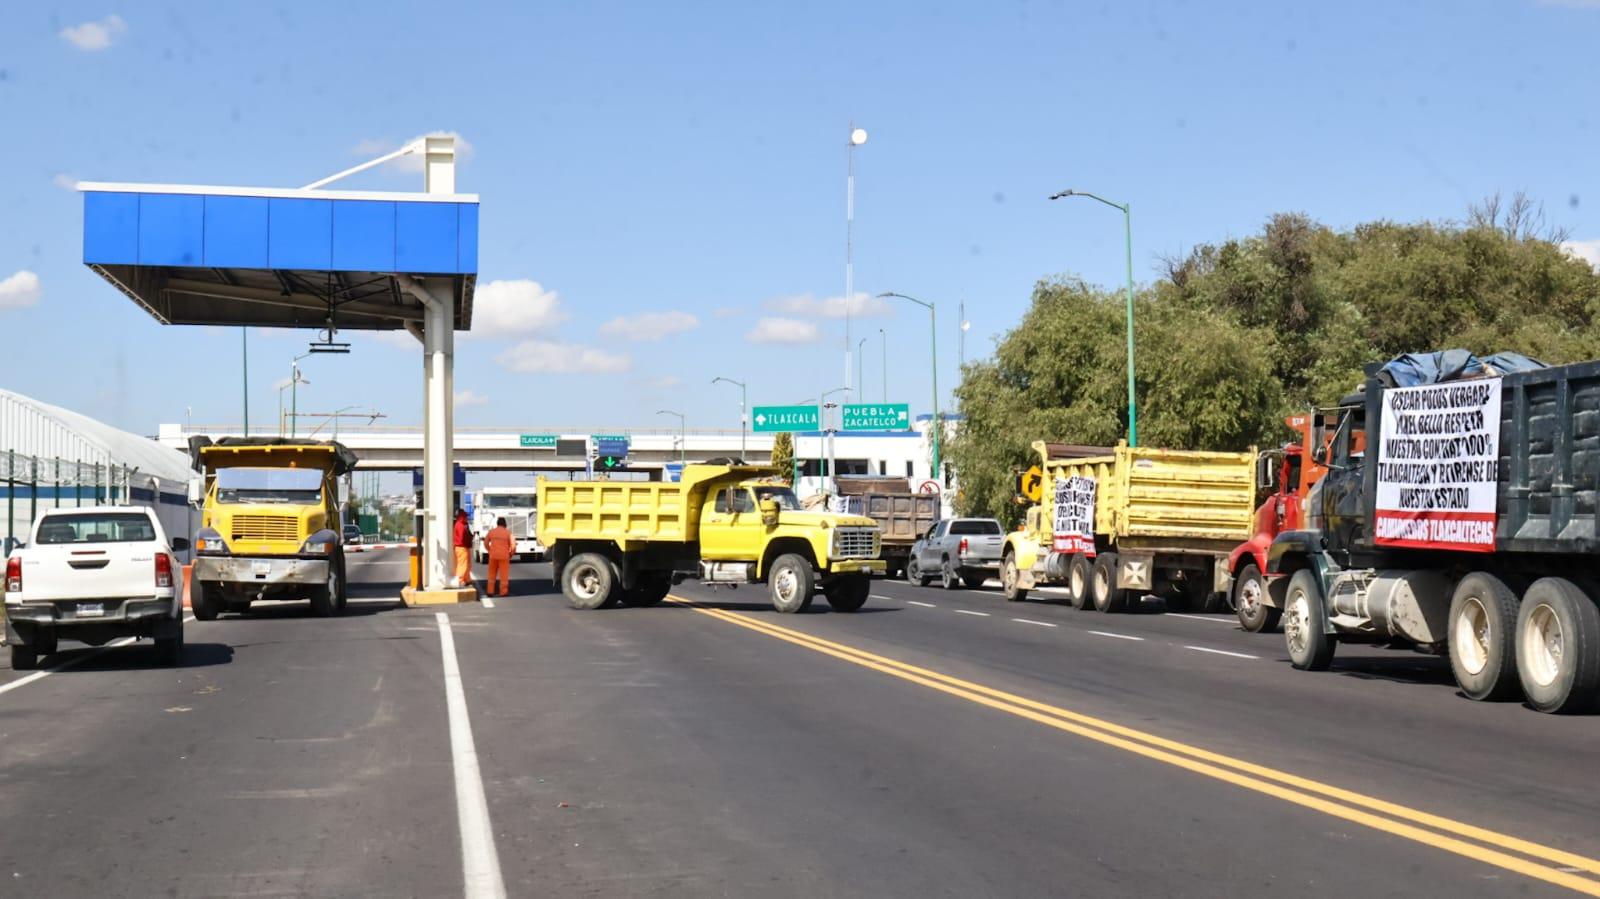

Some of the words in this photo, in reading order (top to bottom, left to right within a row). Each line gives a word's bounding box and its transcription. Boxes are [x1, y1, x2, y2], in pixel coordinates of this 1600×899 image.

[1391, 389, 1420, 411] OSCAR
[1422, 387, 1448, 410] POZOS
[768, 413, 817, 425] TLAXCALA
[844, 407, 895, 416] PUEBLA
[845, 417, 896, 427] ZACATELCO
[1418, 413, 1443, 435] BELLO
[1386, 438, 1422, 460] NUESTRO
[1430, 463, 1437, 484] Y
[1486, 460, 1498, 482] DE
[1399, 487, 1434, 509] NUESTRO
[1434, 487, 1470, 509] ESTADO
[1429, 519, 1494, 545] TLAXCALTECAS
